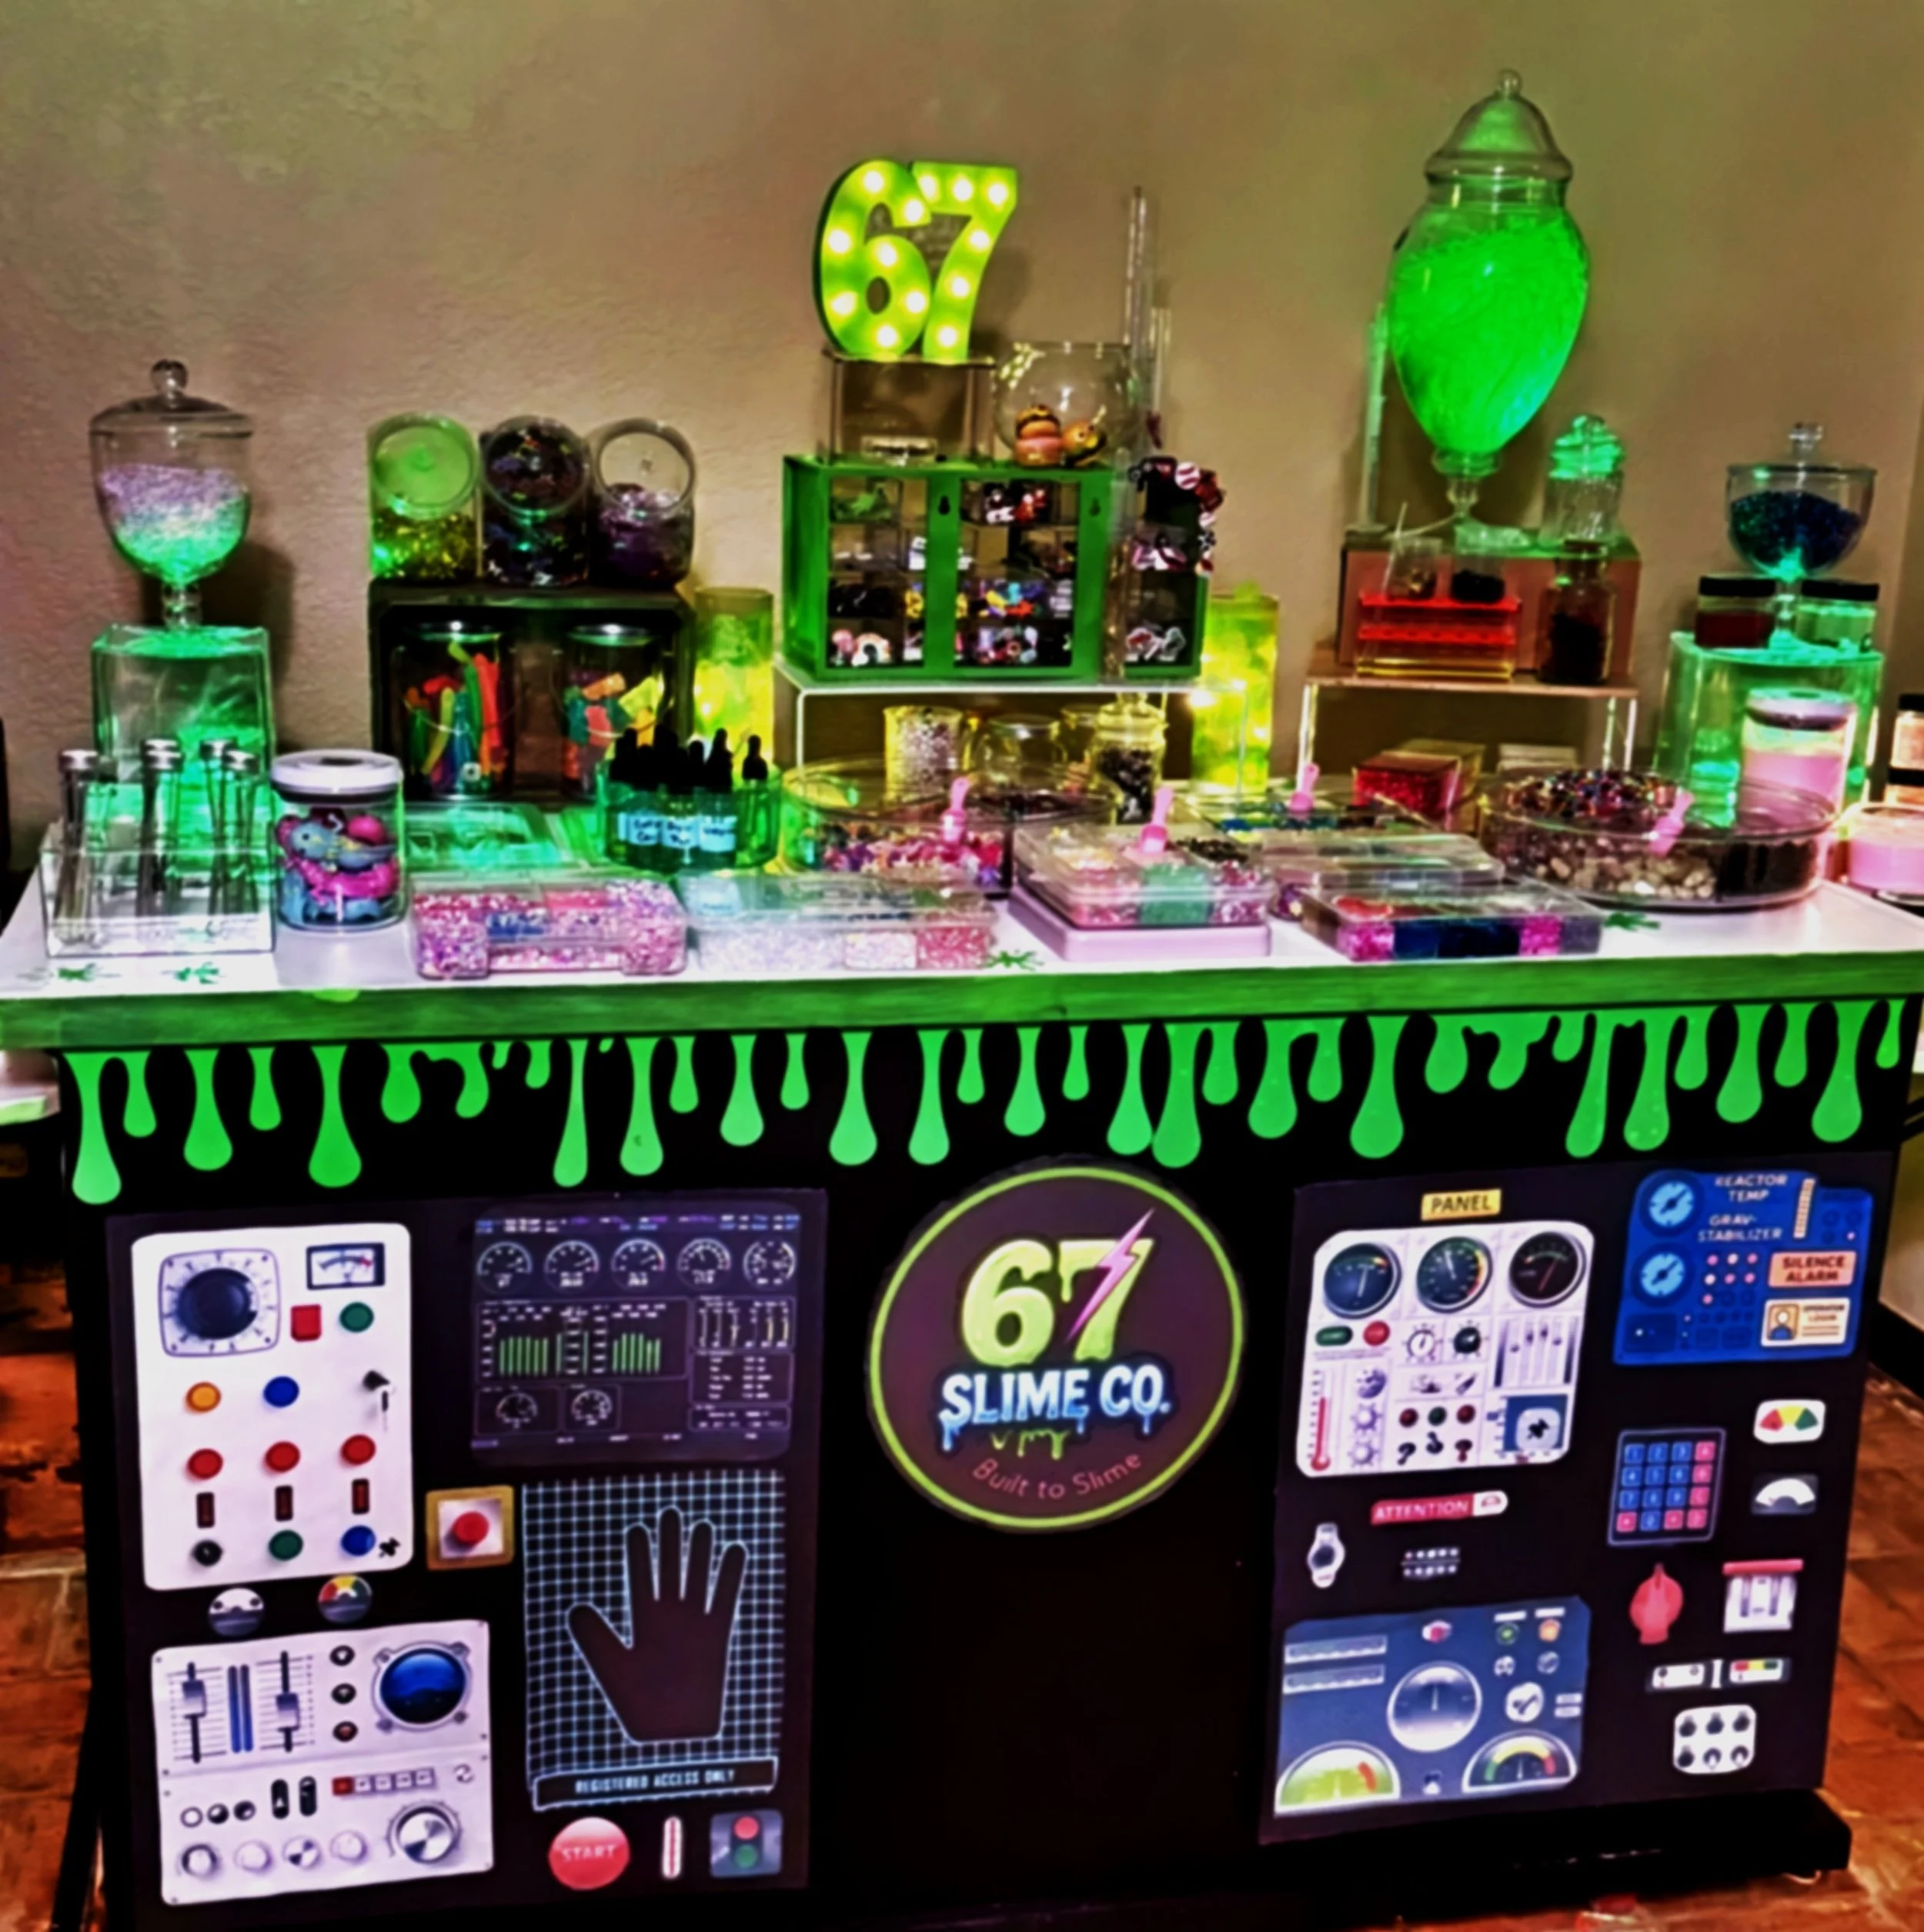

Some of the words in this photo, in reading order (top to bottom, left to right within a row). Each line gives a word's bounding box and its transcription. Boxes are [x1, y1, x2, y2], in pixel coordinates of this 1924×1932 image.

[813, 159, 1017, 364] 67
[1715, 1175, 1789, 1187] REACTOR
[1430, 1194, 1493, 1213] PANEL
[1729, 1190, 1770, 1203] TEMP
[1709, 1214, 1758, 1226] GRAV-
[1697, 1229, 1783, 1243] STABILIZER
[1782, 1256, 1846, 1270] SILENCE
[1785, 1270, 1839, 1283] ALARM
[962, 1239, 1154, 1367] 67
[938, 1368, 1090, 1445] SLIME
[1098, 1364, 1172, 1431] CO.
[972, 1458, 1027, 1497] Built
[1037, 1478, 1065, 1500] to
[1072, 1453, 1142, 1496] Slime
[1374, 1500, 1470, 1520] ATTENTION
[575, 1774, 649, 1794] REGISTERED
[653, 1770, 700, 1787] ACCESS
[704, 1769, 736, 1784] ONLY
[562, 1844, 616, 1863] START
